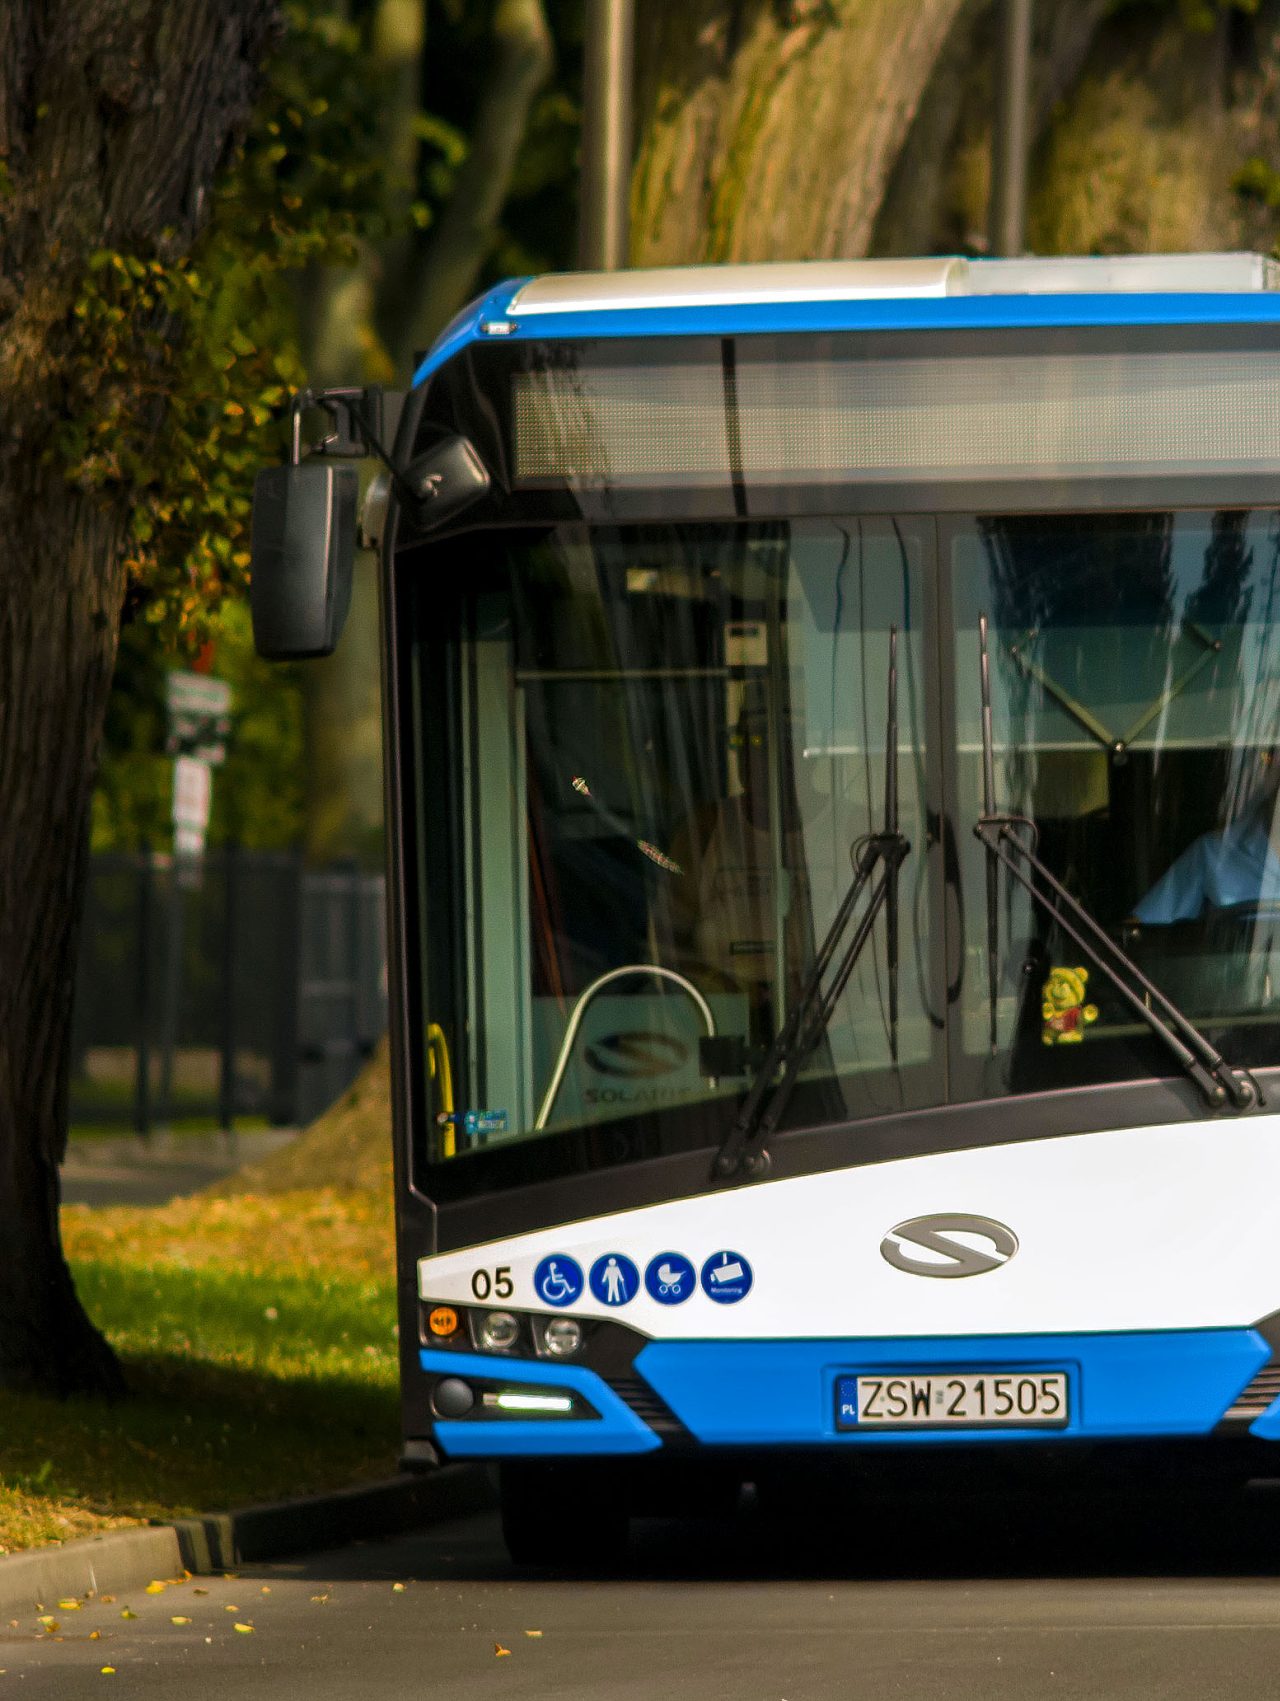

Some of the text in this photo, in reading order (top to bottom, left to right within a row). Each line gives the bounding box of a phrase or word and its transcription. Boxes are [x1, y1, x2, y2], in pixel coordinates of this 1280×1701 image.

[471, 1266, 514, 1300] 05
[842, 1404, 855, 1415] PL
[862, 1379, 1060, 1417] ZSW 21505
